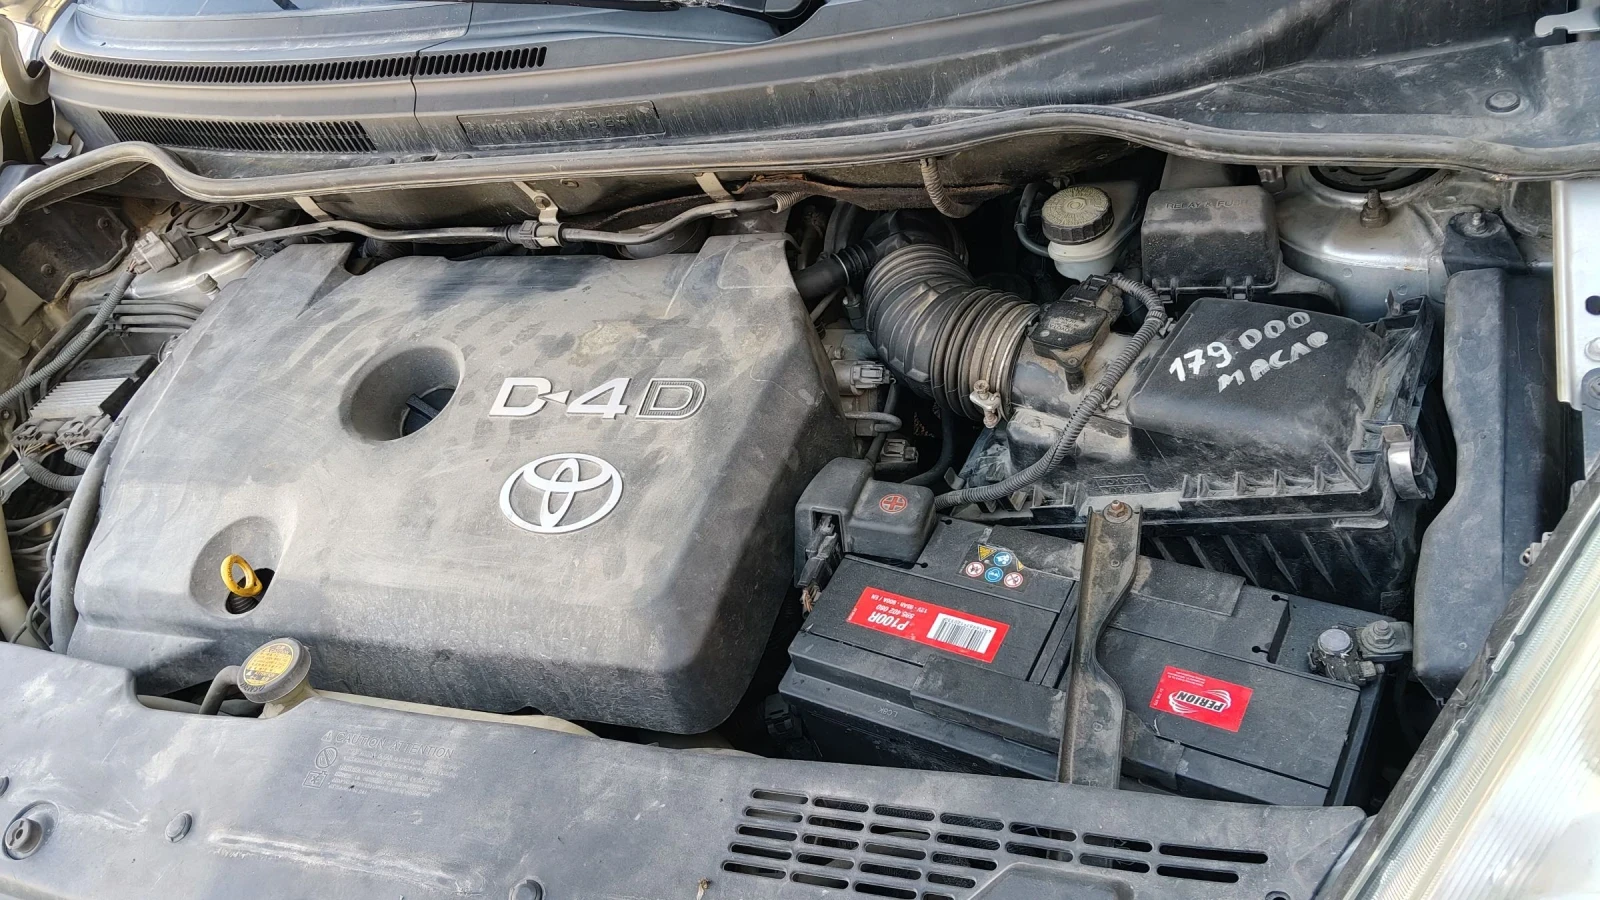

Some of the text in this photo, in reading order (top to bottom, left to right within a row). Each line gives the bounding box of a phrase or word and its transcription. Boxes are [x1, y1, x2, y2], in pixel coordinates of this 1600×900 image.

[1166, 201, 1201, 210] RELAY
[1216, 200, 1248, 209] FU
[867, 611, 910, 631] P100R
[1176, 691, 1224, 711] PERION
[335, 731, 454, 759] CAUTION ATTENTION
